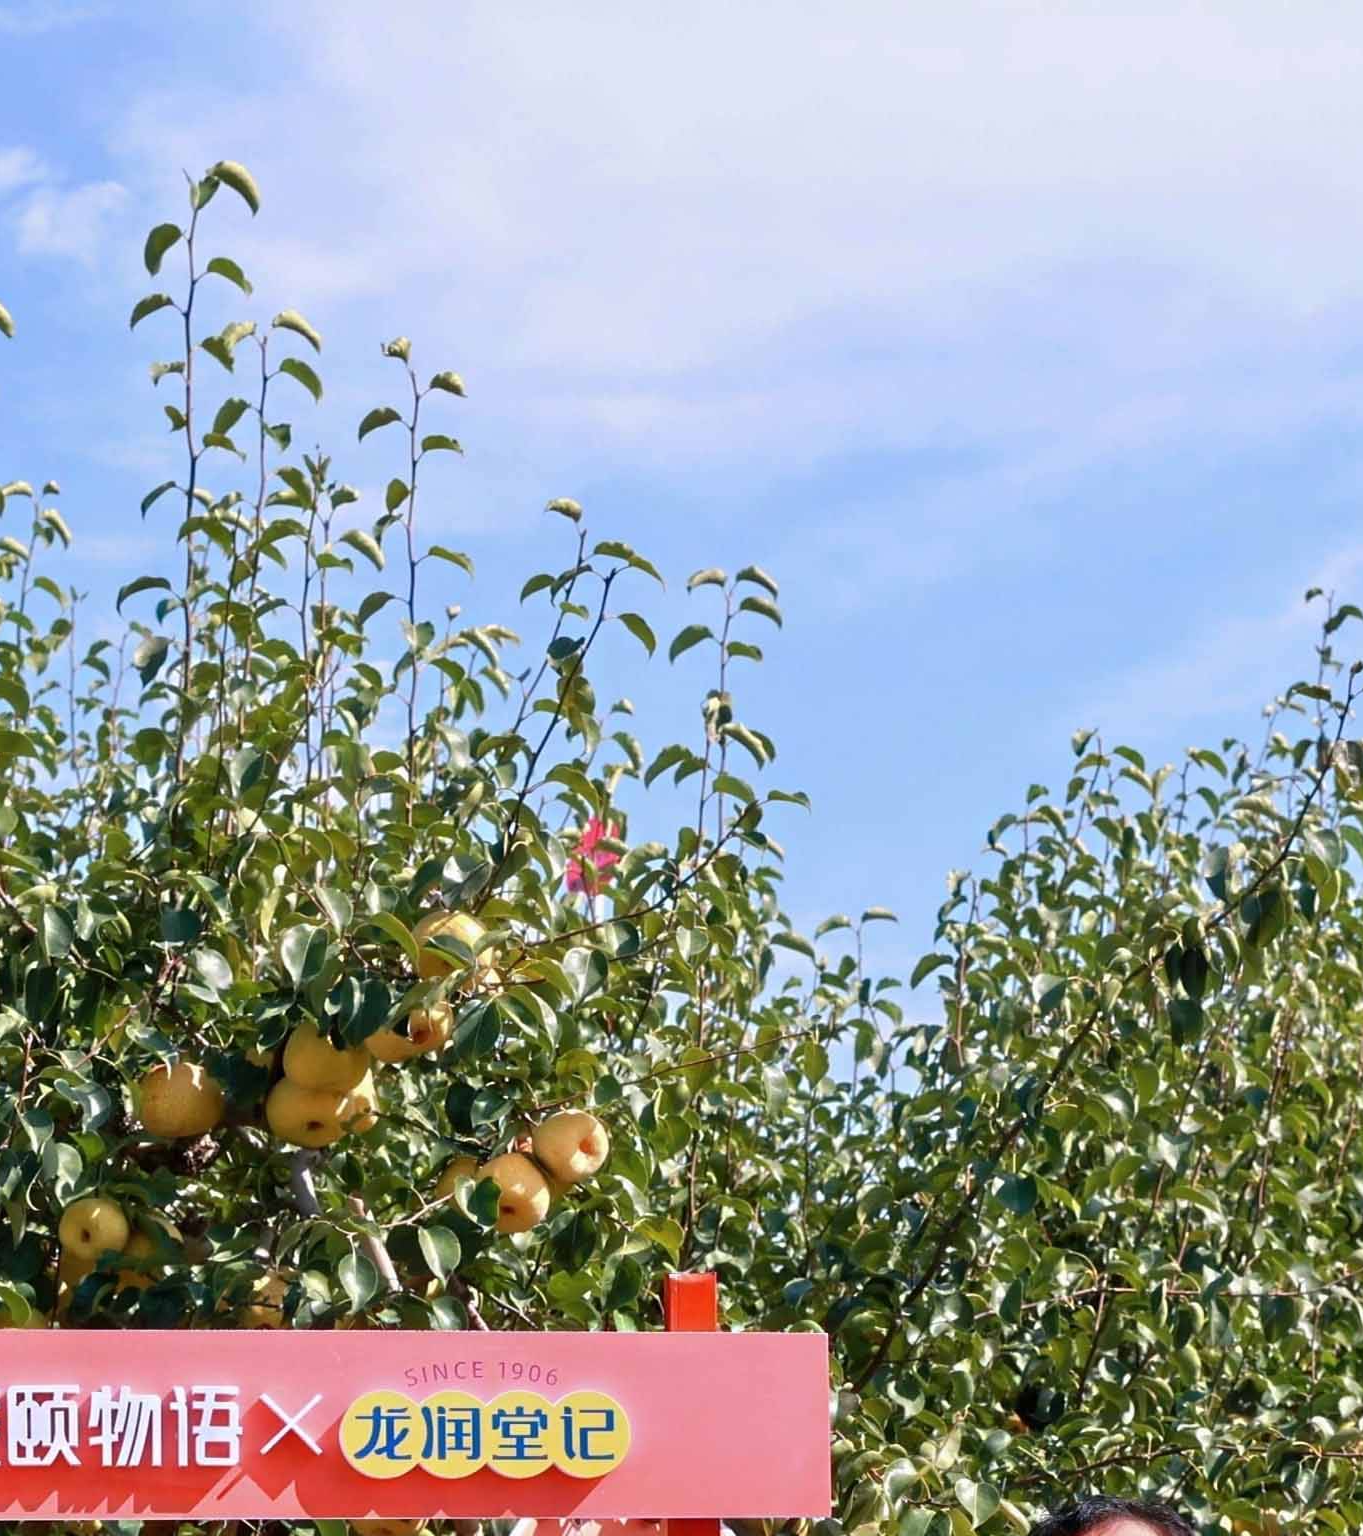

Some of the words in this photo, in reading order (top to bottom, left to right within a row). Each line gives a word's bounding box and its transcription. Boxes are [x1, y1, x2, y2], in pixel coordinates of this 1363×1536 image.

[404, 1360, 485, 1388] SINCE
[498, 1360, 560, 1387] 1906
[354, 1404, 617, 1463] 龙润堂记
